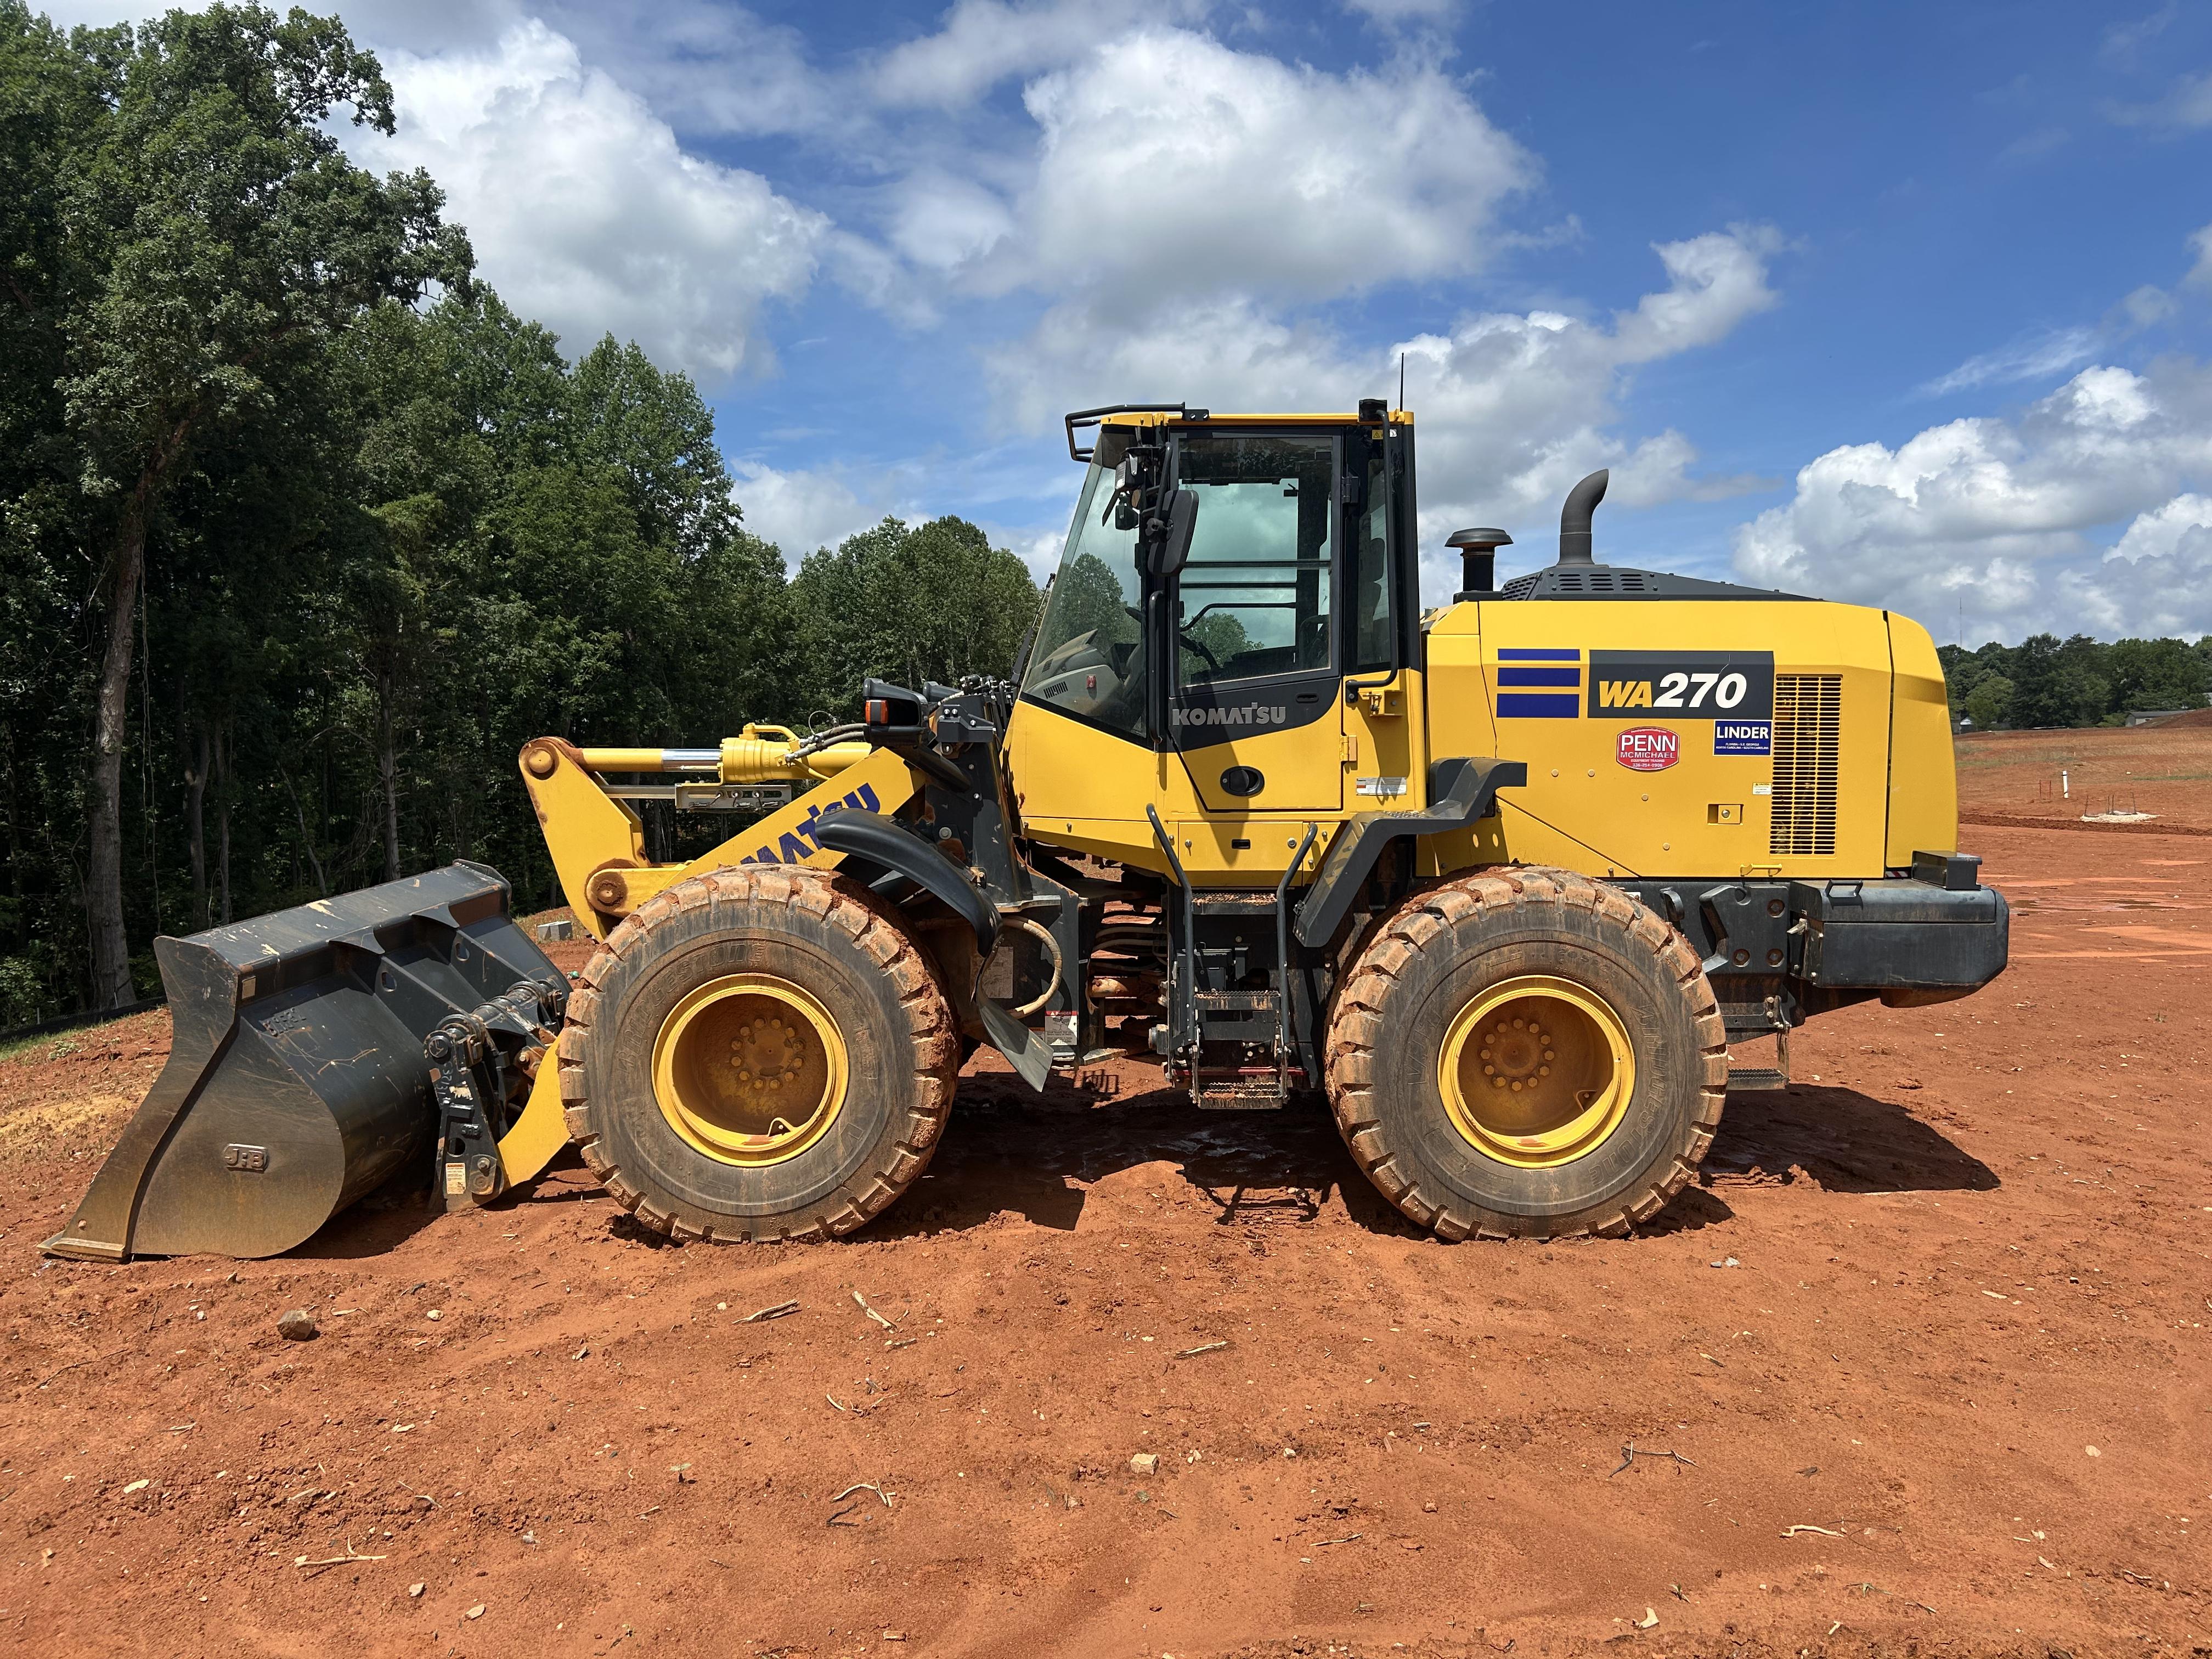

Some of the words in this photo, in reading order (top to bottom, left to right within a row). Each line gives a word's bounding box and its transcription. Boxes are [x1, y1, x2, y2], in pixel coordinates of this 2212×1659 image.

[1599, 673, 1747, 708] WA270
[1172, 702, 1286, 726] KOMATSU
[1621, 735, 1675, 751] PENN
[1717, 726, 1769, 739] LINDER
[1589, 1005, 1668, 1187] BRIDGESTONE
